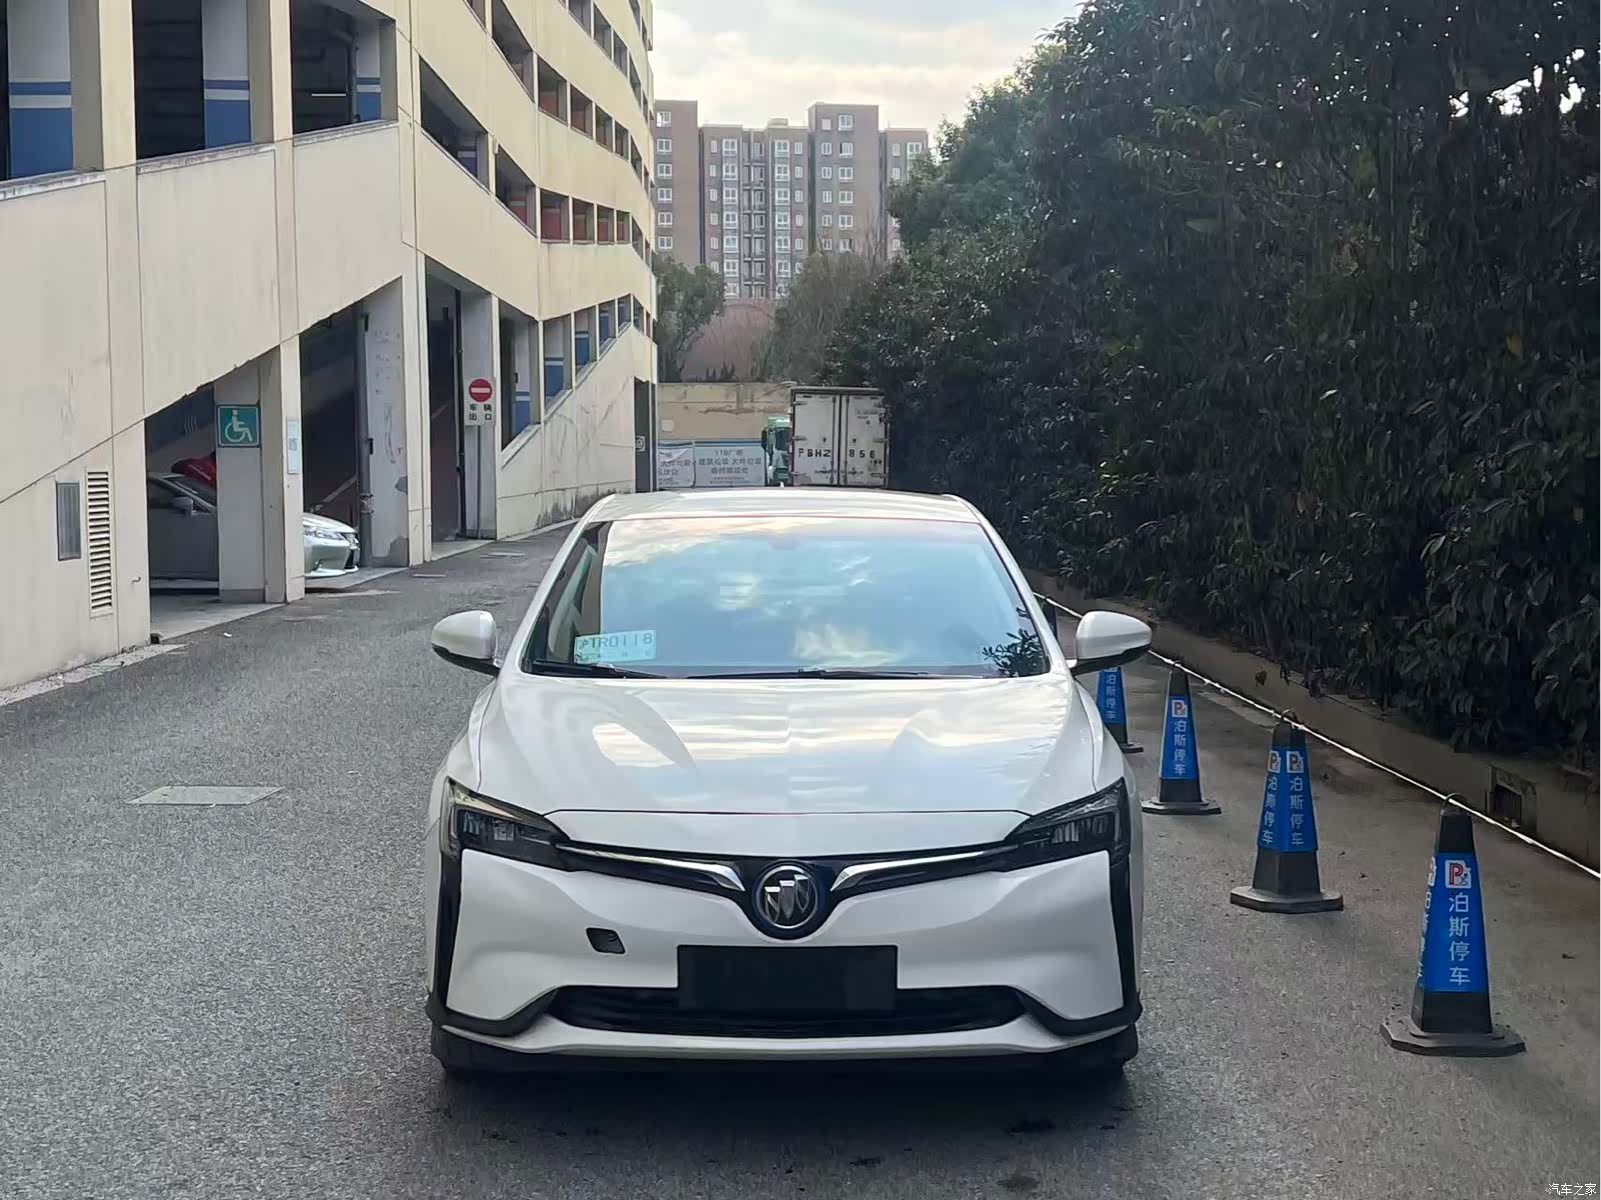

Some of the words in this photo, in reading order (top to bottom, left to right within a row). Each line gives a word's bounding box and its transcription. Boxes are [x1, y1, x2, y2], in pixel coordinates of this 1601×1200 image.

[848, 449, 876, 459] 856
[1173, 720, 1187, 776] 泊斯停车
[1290, 776, 1305, 846] 泊斯停车
[1448, 892, 1471, 986] 泊斯停车
